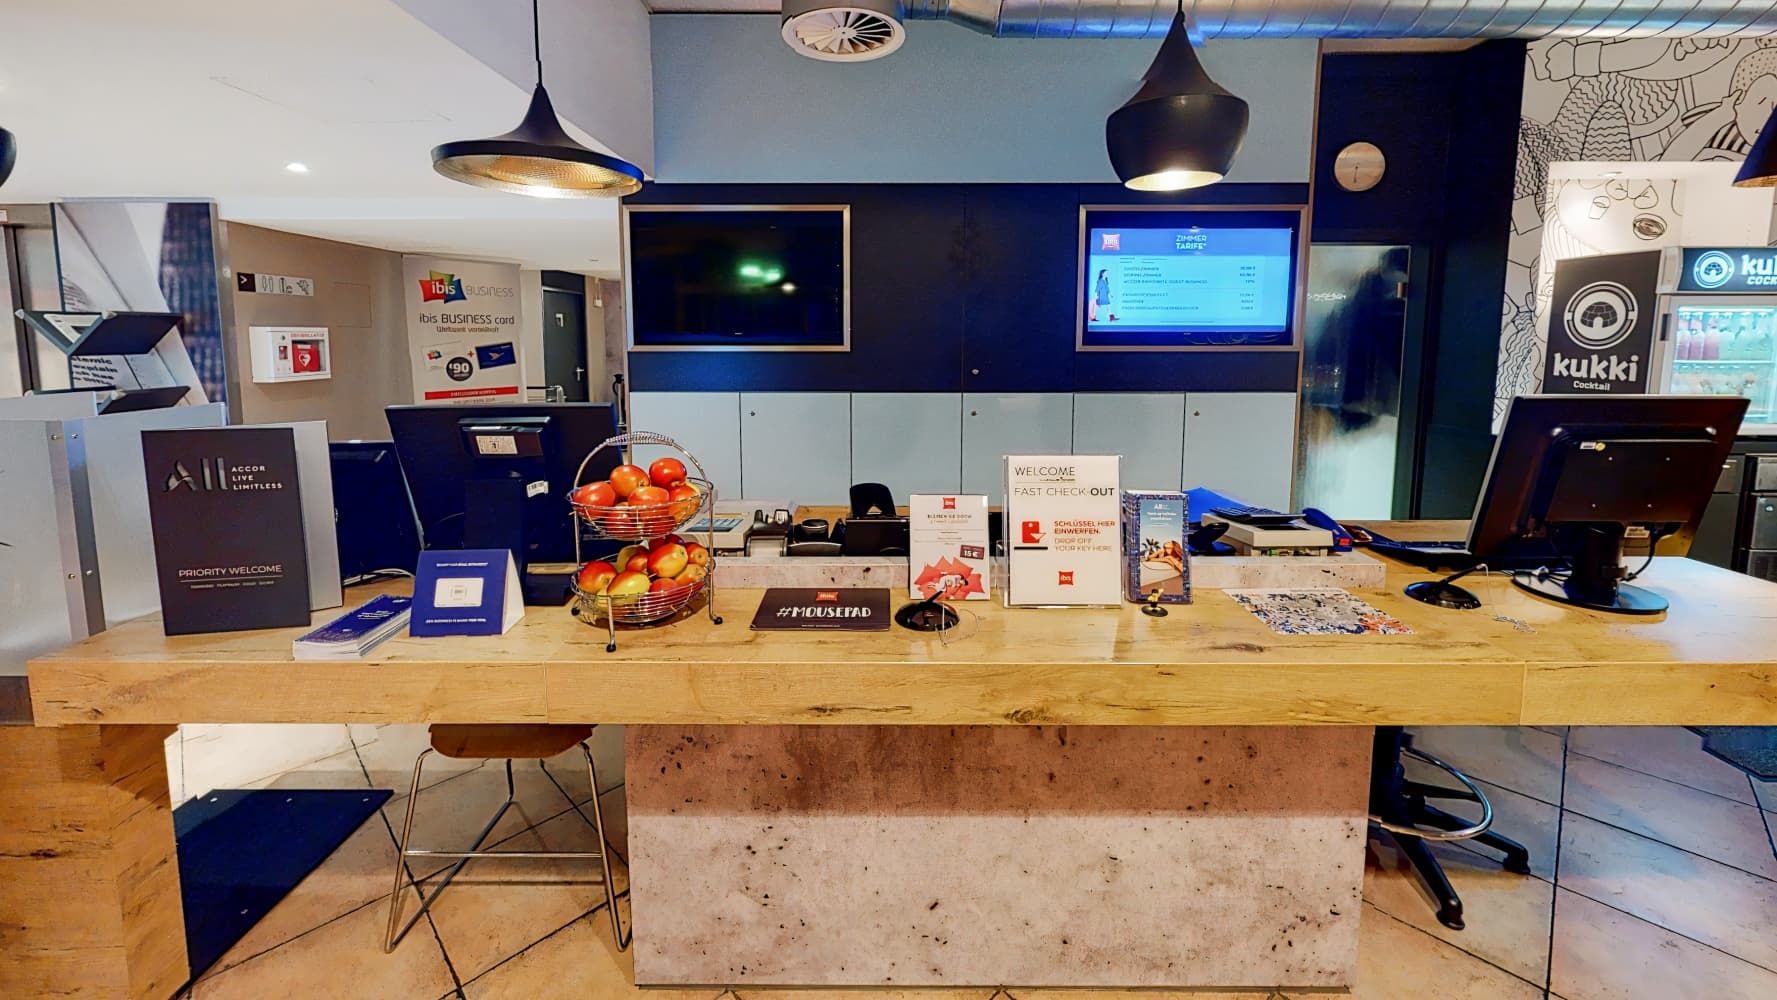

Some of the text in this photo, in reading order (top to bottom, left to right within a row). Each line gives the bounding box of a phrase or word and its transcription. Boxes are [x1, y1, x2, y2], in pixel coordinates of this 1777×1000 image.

[1175, 234, 1207, 242] ZIMMER
[431, 281, 514, 298] ibis BUSINESS
[419, 312, 438, 324] ibis
[441, 313, 492, 325] BUSINESS
[1552, 353, 1639, 382] kukki
[1573, 380, 1611, 391] Cocktail
[1014, 466, 1076, 476] WELCOME
[233, 483, 283, 491] LIMITLESS
[1014, 487, 1115, 496] FAST CHECK-OUT
[178, 564, 282, 577] PRIORITY WELCOME
[776, 606, 872, 618] #MOUSEPAD
